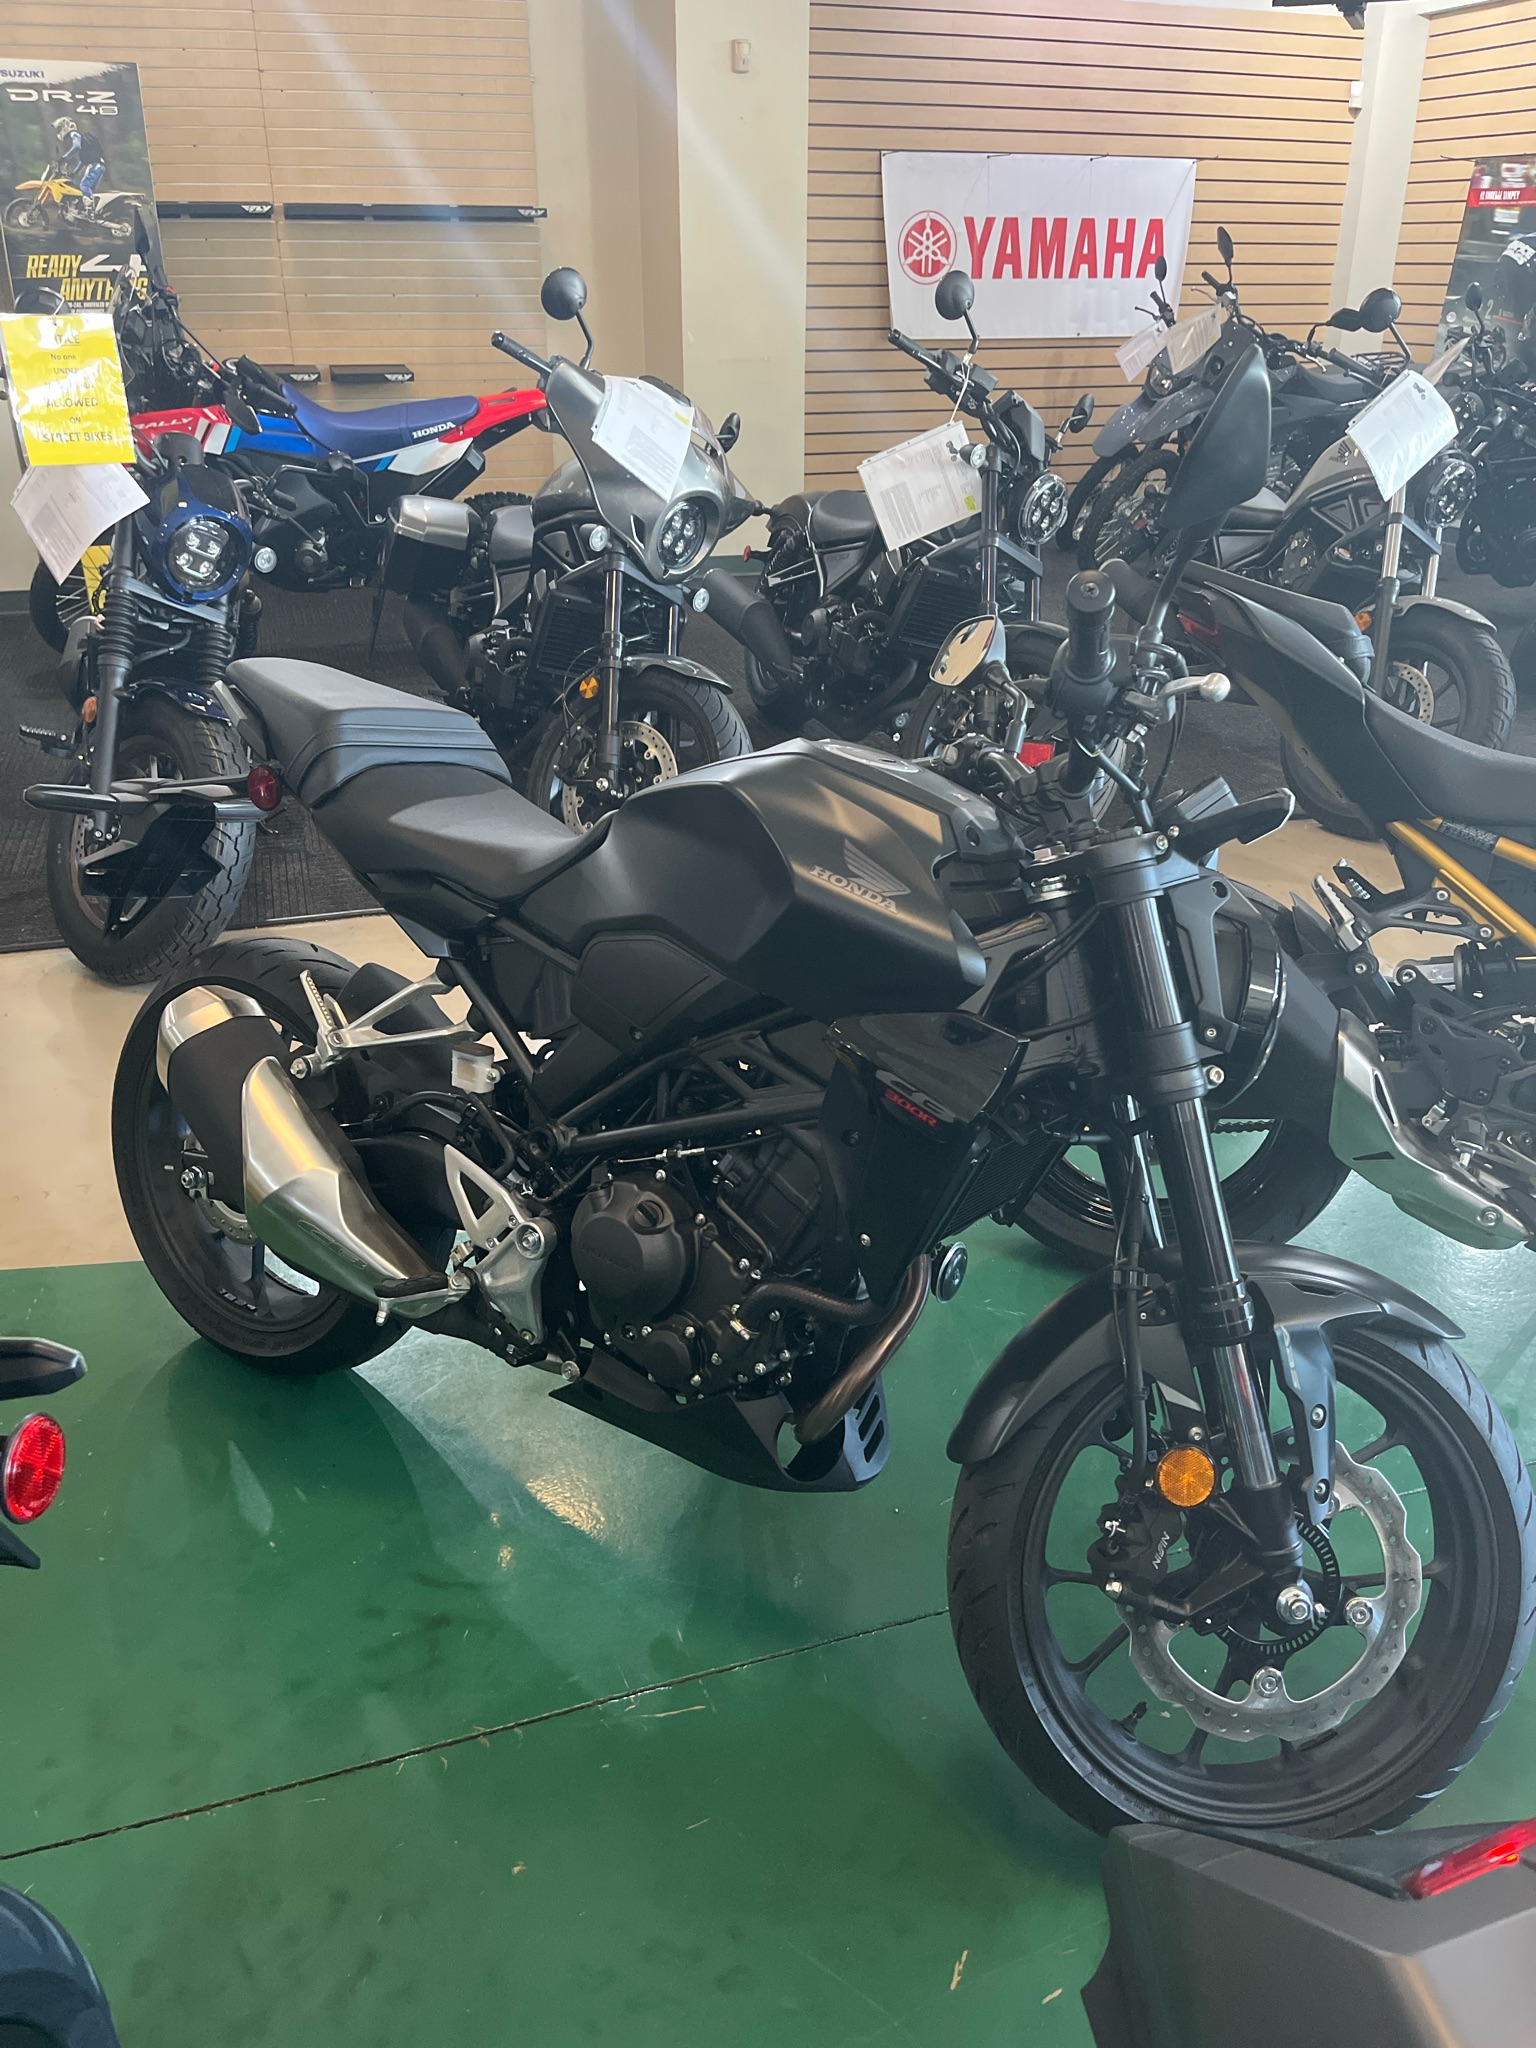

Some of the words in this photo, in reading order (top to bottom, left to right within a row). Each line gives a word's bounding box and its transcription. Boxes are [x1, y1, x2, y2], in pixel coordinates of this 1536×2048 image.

[0, 69, 45, 79] SUZUKI
[6, 88, 117, 104] DR-Z
[963, 215, 1165, 280] YAMAHA
[26, 254, 83, 278] READY
[59, 277, 149, 301] ANYTHG
[46, 397, 99, 408] ALLOWED
[69, 416, 81, 424] ON
[43, 432, 81, 443] STREET
[84, 431, 113, 442] BIKES
[411, 421, 457, 439] HONDA
[809, 865, 898, 915] HONDA
[1151, 1530, 1170, 1570] NISSIN
